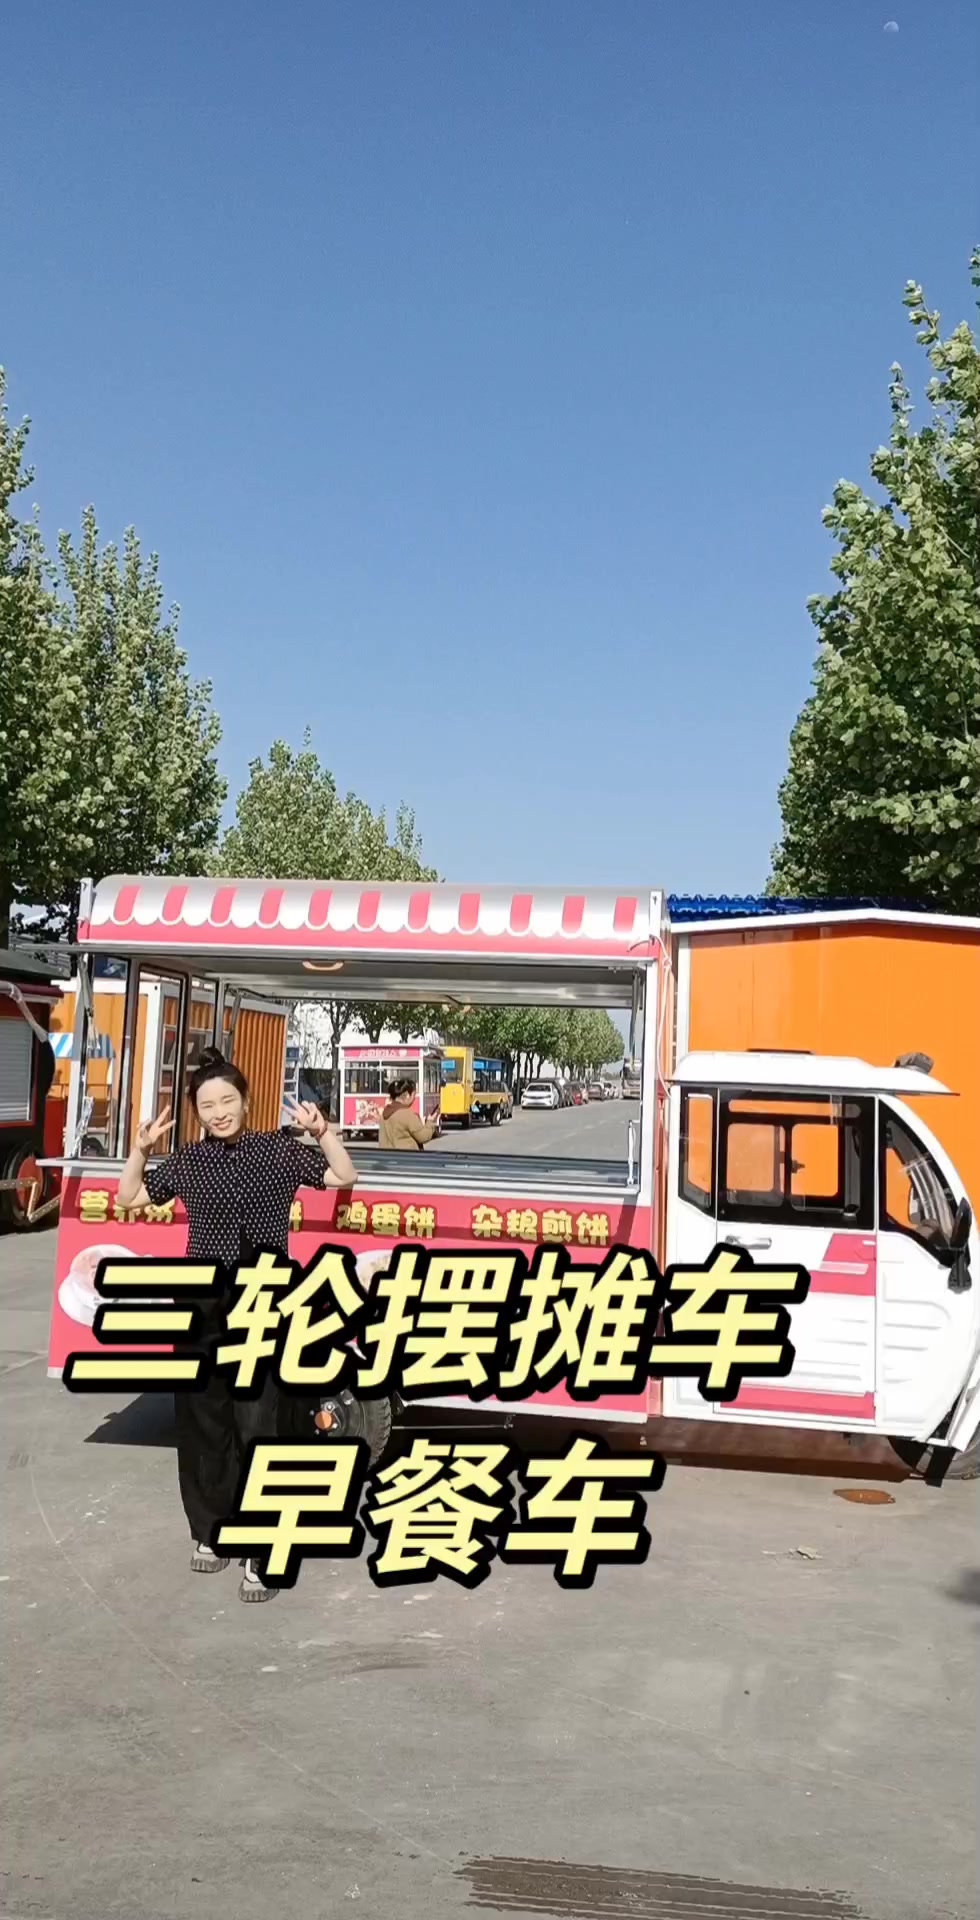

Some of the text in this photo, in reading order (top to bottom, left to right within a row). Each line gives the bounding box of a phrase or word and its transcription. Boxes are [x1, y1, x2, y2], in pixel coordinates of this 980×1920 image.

[336, 1200, 436, 1239] 鸡蛋饼
[471, 1203, 609, 1246] 杂粮煎饼
